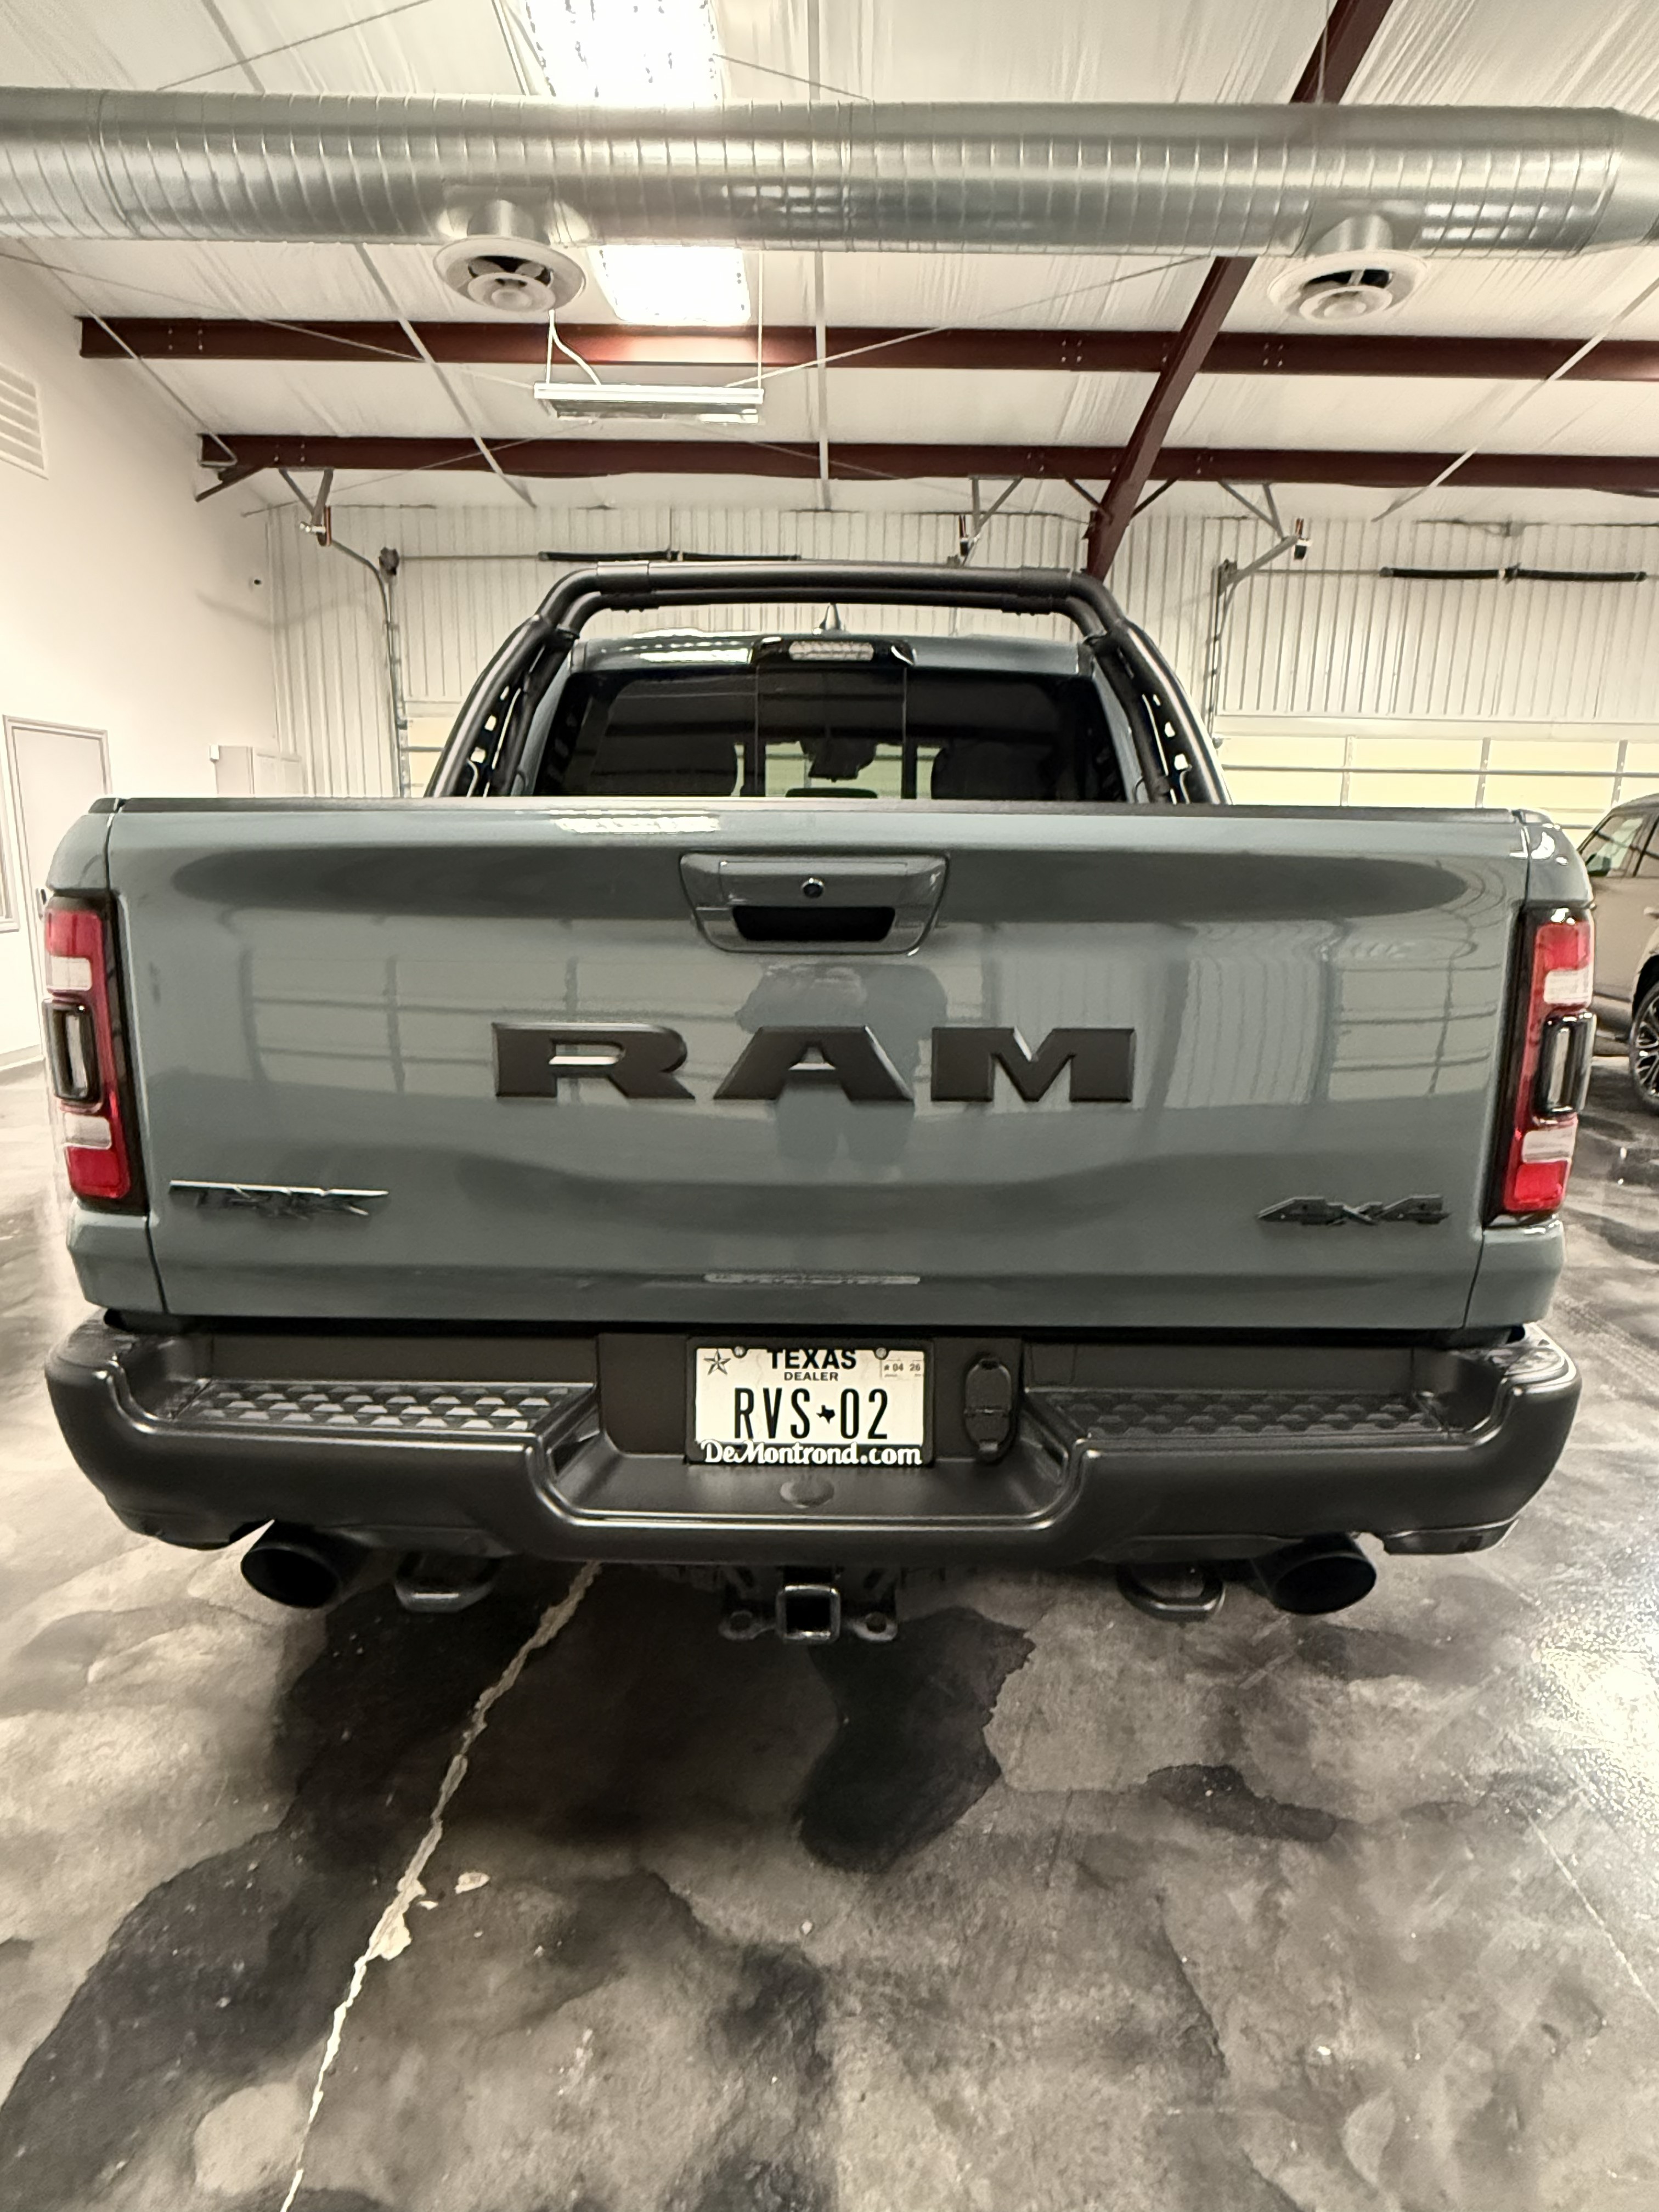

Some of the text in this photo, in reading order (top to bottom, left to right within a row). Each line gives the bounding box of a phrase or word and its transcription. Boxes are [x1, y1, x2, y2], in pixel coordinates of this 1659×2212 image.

[493, 1023, 1135, 1102] RAM
[767, 1349, 856, 1369] TEXAS
[784, 1372, 838, 1381] DEALER
[734, 1387, 888, 1440] RVS 02
[700, 1439, 923, 1465] DeMontrond.com
